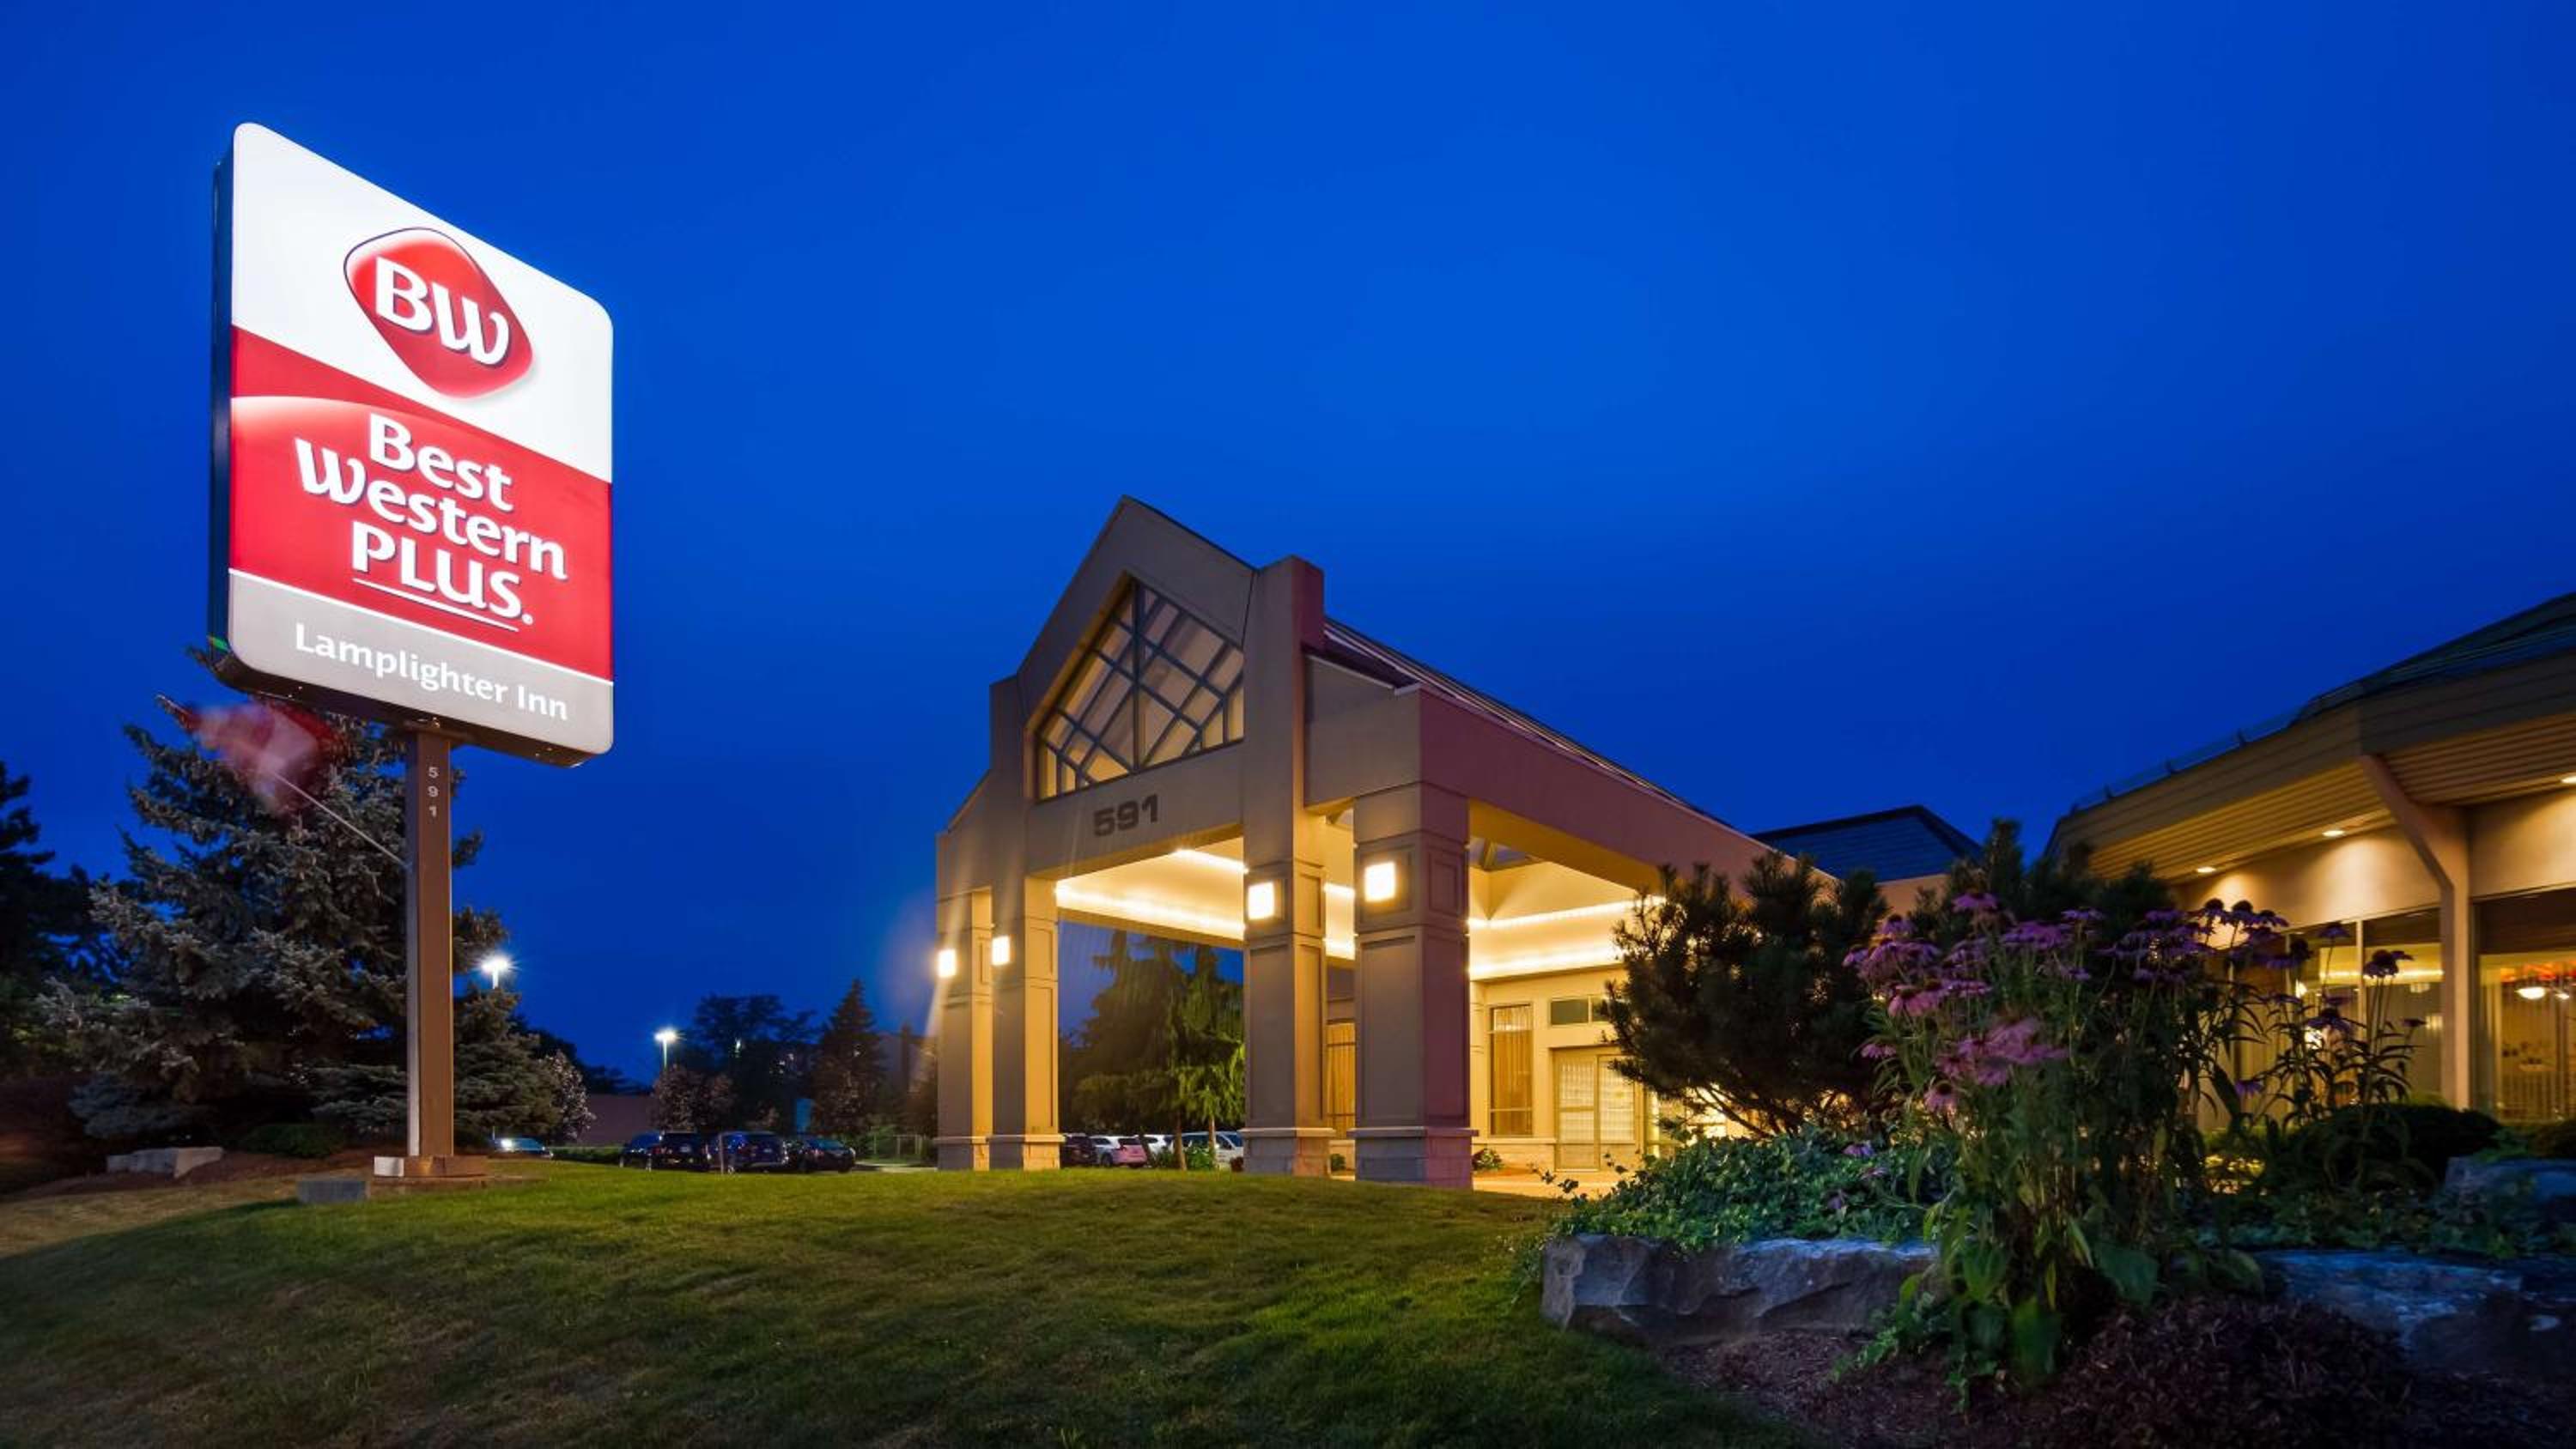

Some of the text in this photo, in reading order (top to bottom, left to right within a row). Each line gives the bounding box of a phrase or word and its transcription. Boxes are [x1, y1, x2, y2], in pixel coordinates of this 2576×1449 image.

[375, 258, 510, 366] BW
[295, 437, 568, 581] Western
[369, 413, 513, 512] Best
[295, 623, 568, 721] Lamplighter Inn
[428, 767, 439, 817] 591
[1093, 794, 1158, 837] 591
